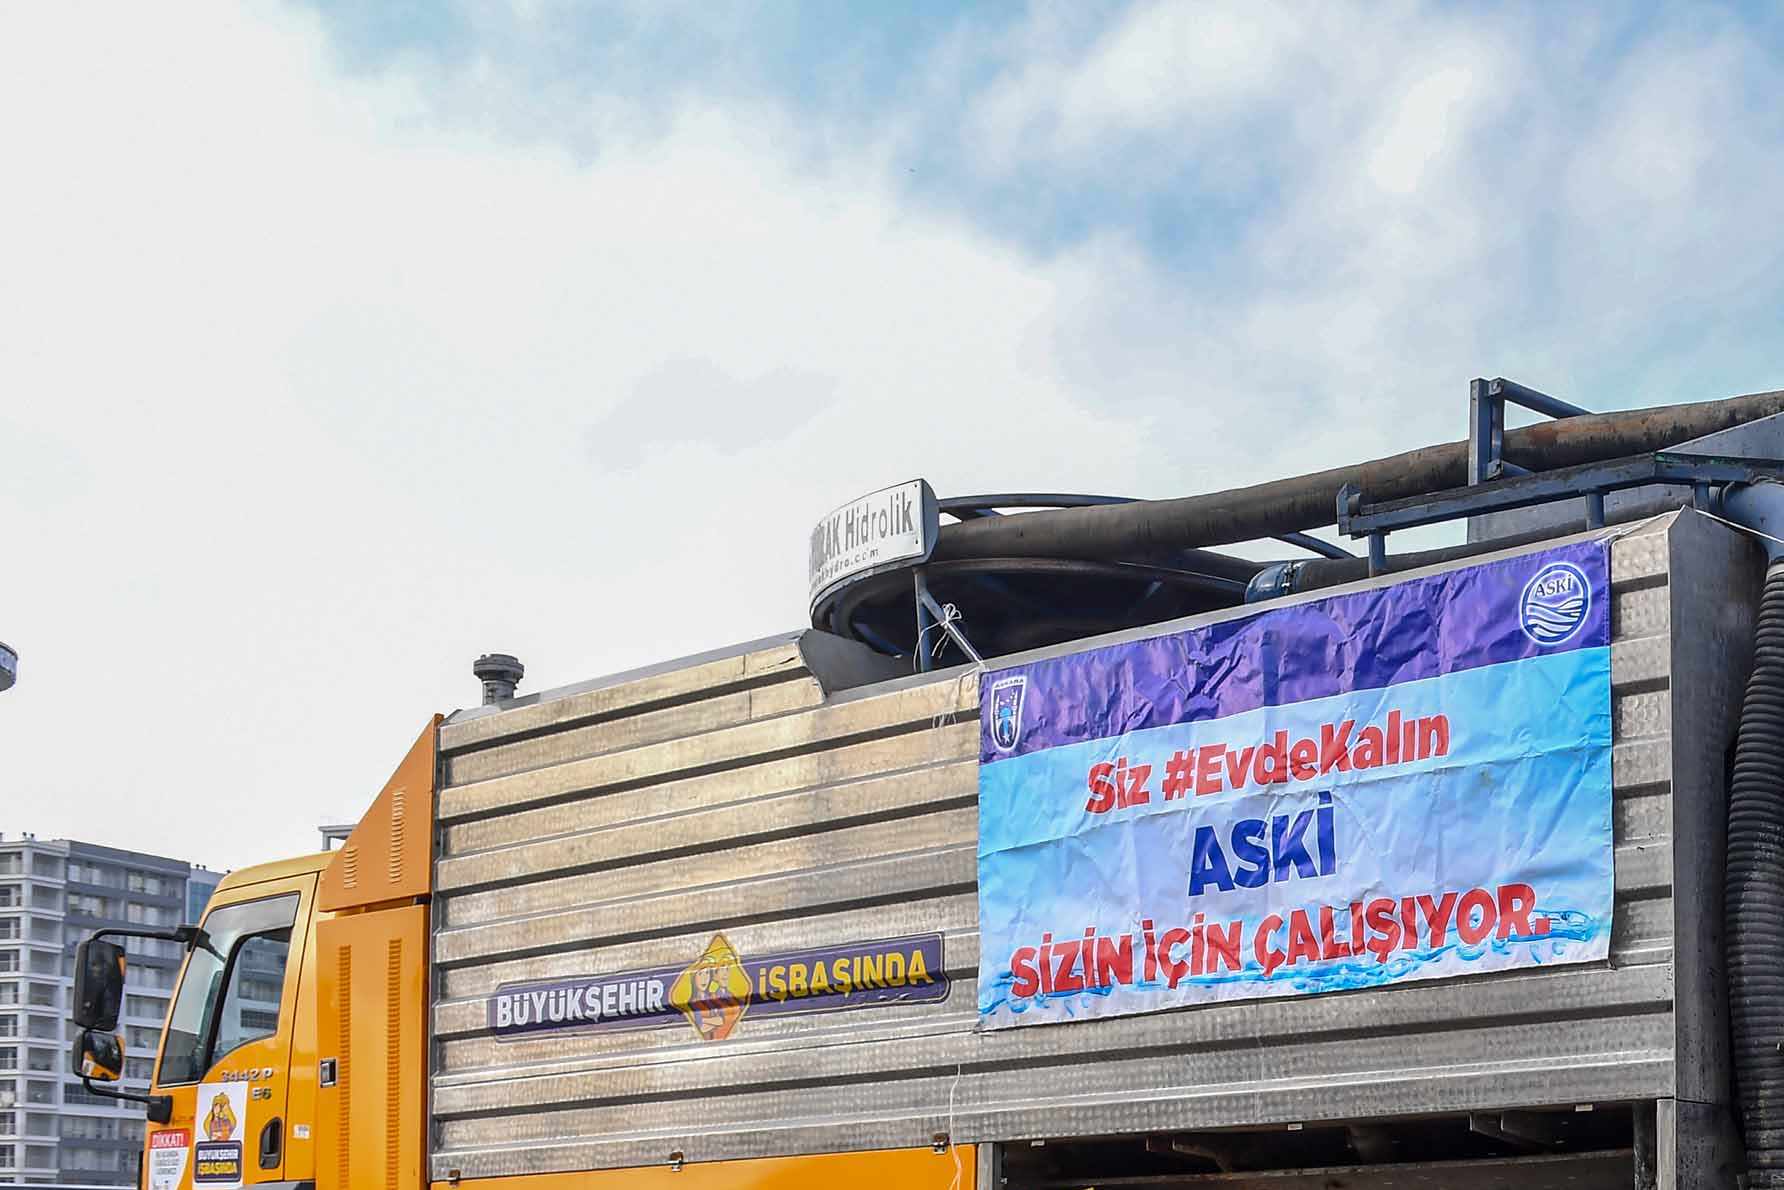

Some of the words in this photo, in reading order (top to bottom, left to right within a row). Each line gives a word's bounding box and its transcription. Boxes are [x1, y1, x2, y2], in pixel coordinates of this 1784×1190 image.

[845, 491, 914, 552] Hidrolik
[1535, 574, 1572, 597] ASKİ
[1084, 760, 1150, 814] Siz
[1162, 710, 1450, 801] #EvdeKalın
[1188, 791, 1337, 897] ASKİ
[1010, 926, 1132, 998] SİZİN
[1142, 912, 1243, 990] İÇİN
[1253, 883, 1552, 977] ÇALIŞIYOR.
[497, 980, 666, 1028] BÜYÜKŞEHİR
[759, 949, 934, 1004] İŞBAŞINDA
